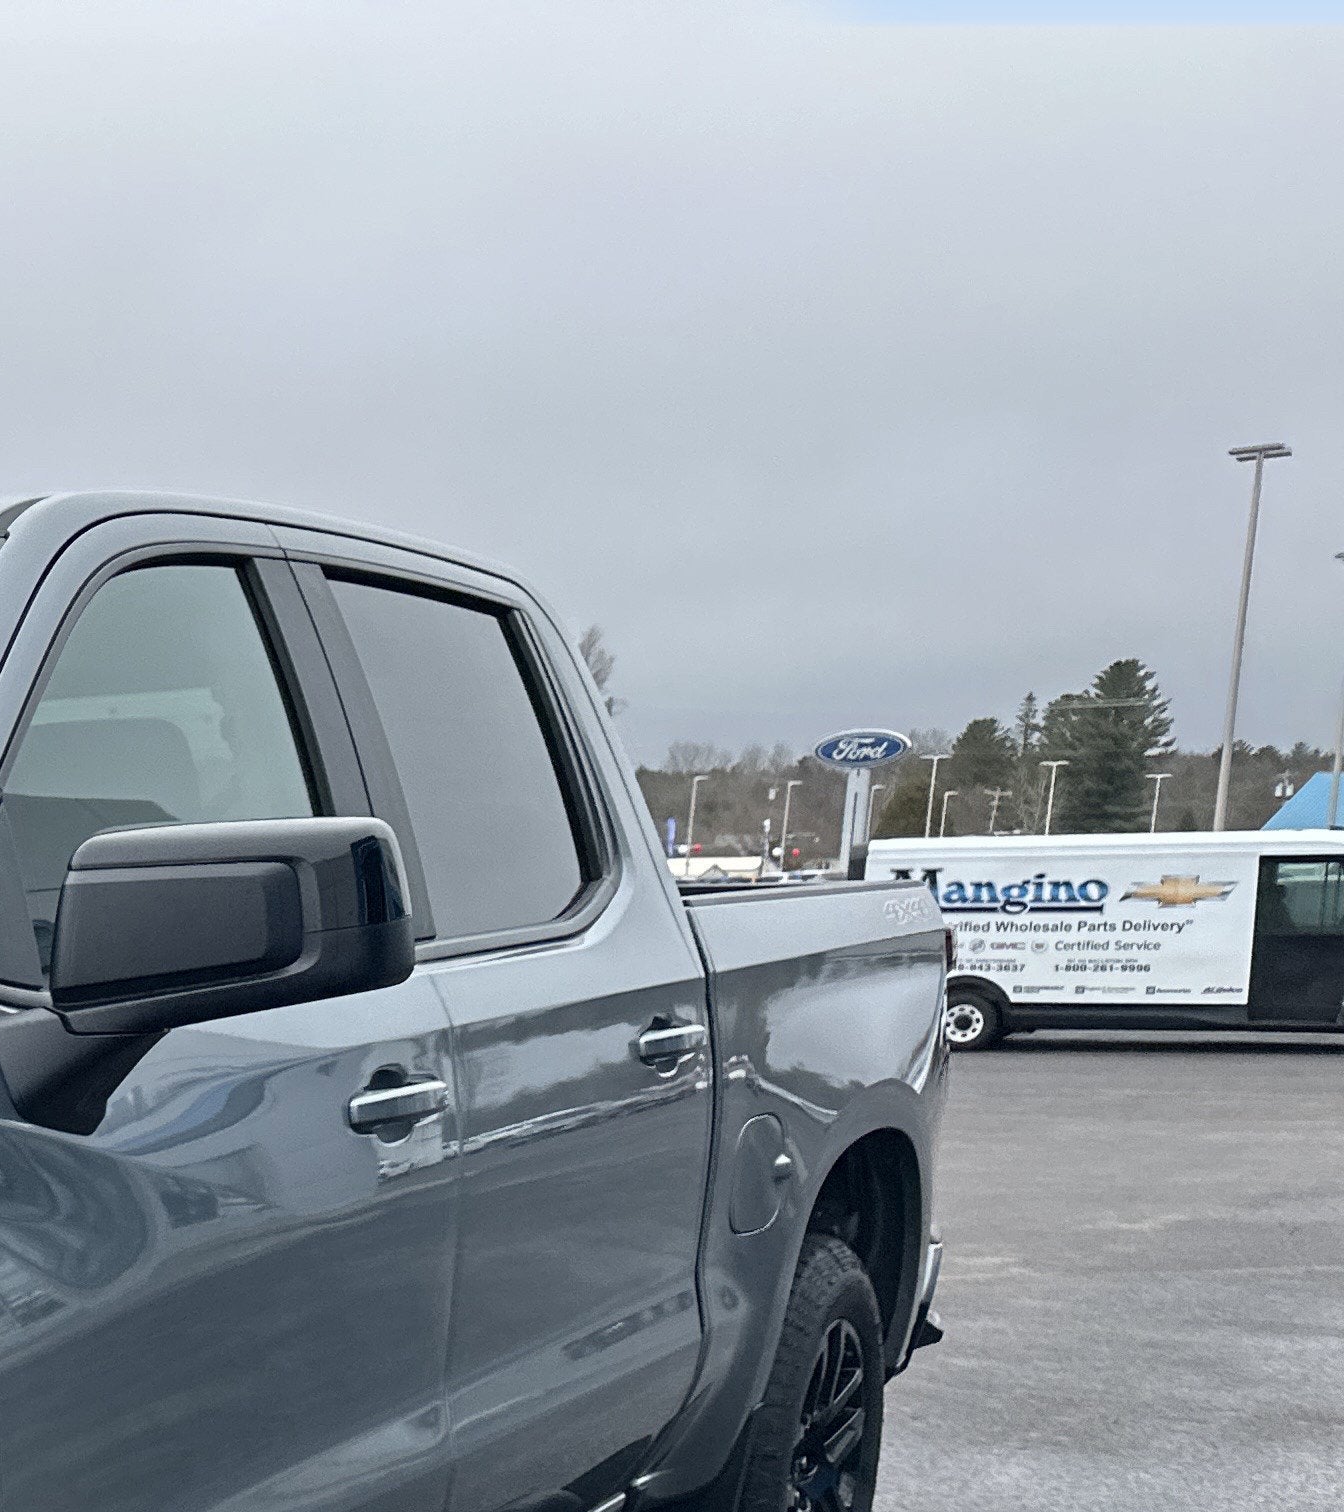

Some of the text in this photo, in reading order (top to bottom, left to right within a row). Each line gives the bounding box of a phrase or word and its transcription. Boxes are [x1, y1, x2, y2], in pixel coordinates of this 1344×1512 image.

[833, 737, 888, 760] Ford
[995, 920, 1072, 932] Wholesale
[1077, 920, 1117, 932] Parts
[1055, 940, 1109, 951] Certified
[1114, 940, 1161, 951] Service
